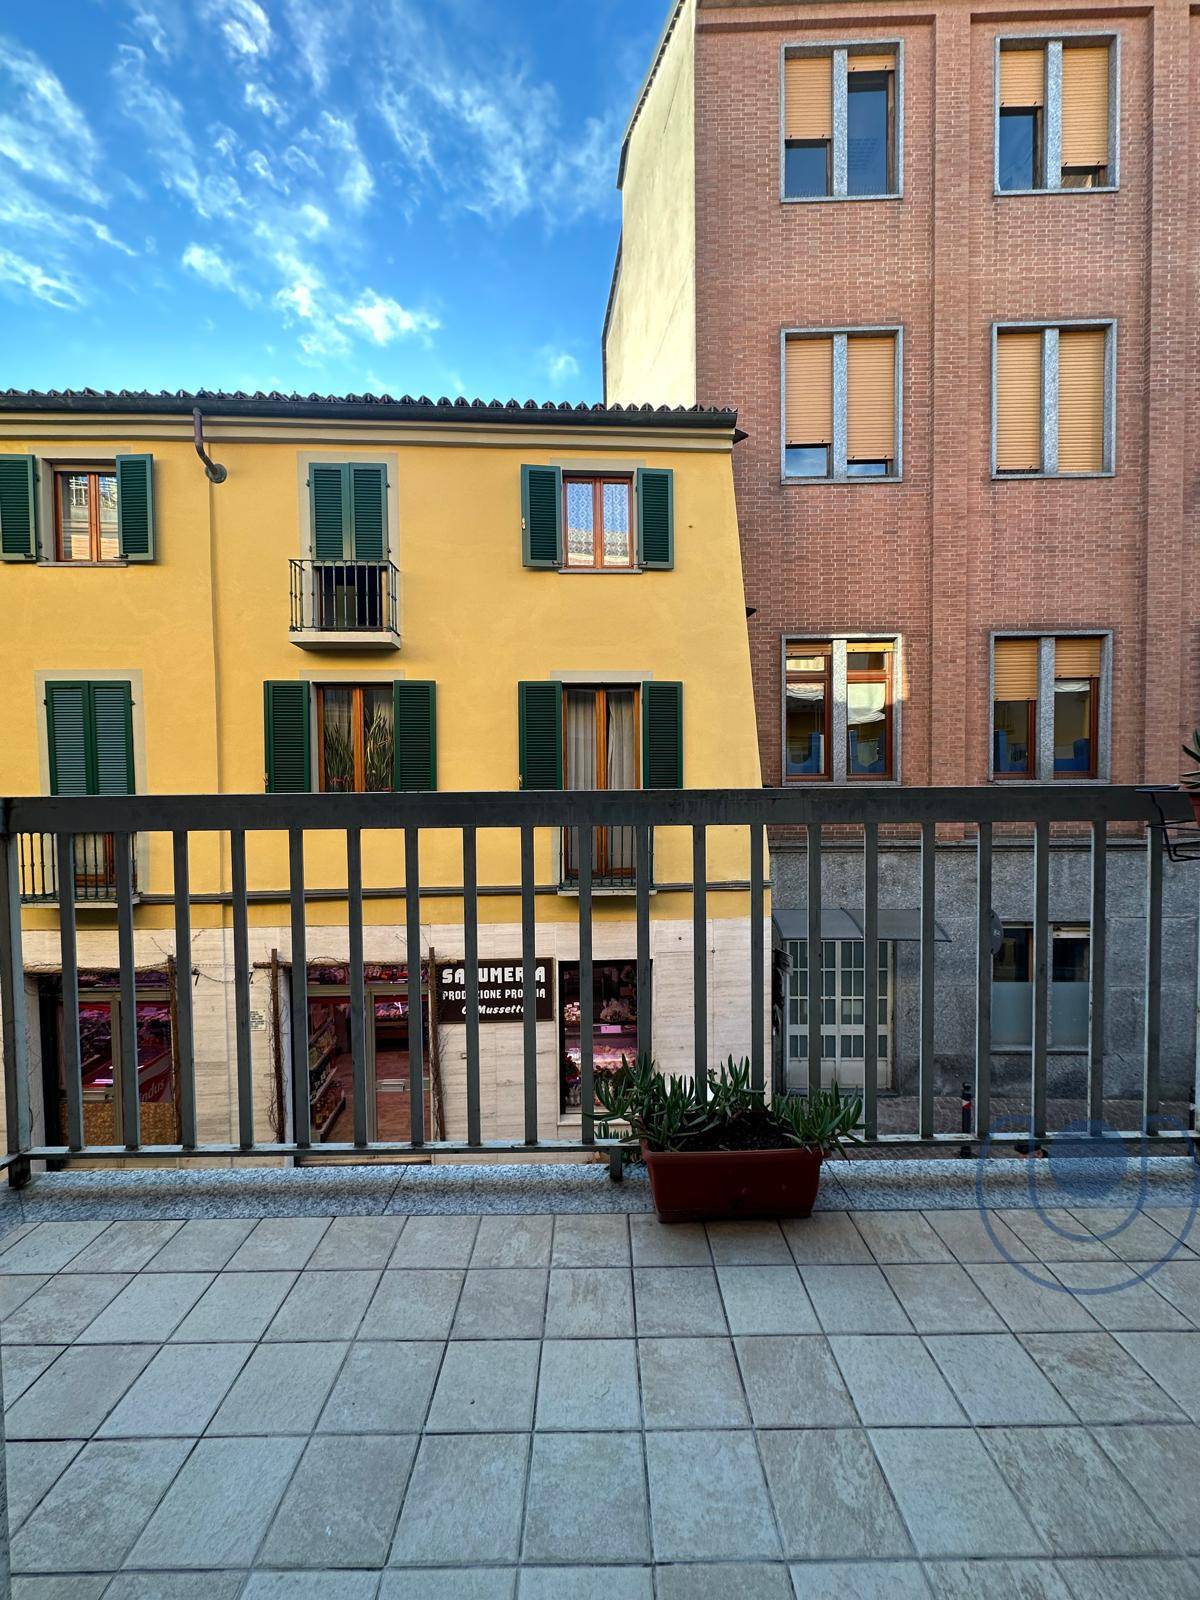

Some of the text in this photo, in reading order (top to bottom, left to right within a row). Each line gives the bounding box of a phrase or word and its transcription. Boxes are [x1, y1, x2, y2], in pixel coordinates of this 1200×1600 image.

[442, 966, 546, 984] SAUMERA
[443, 988, 546, 1000] PRODIONE PROIA
